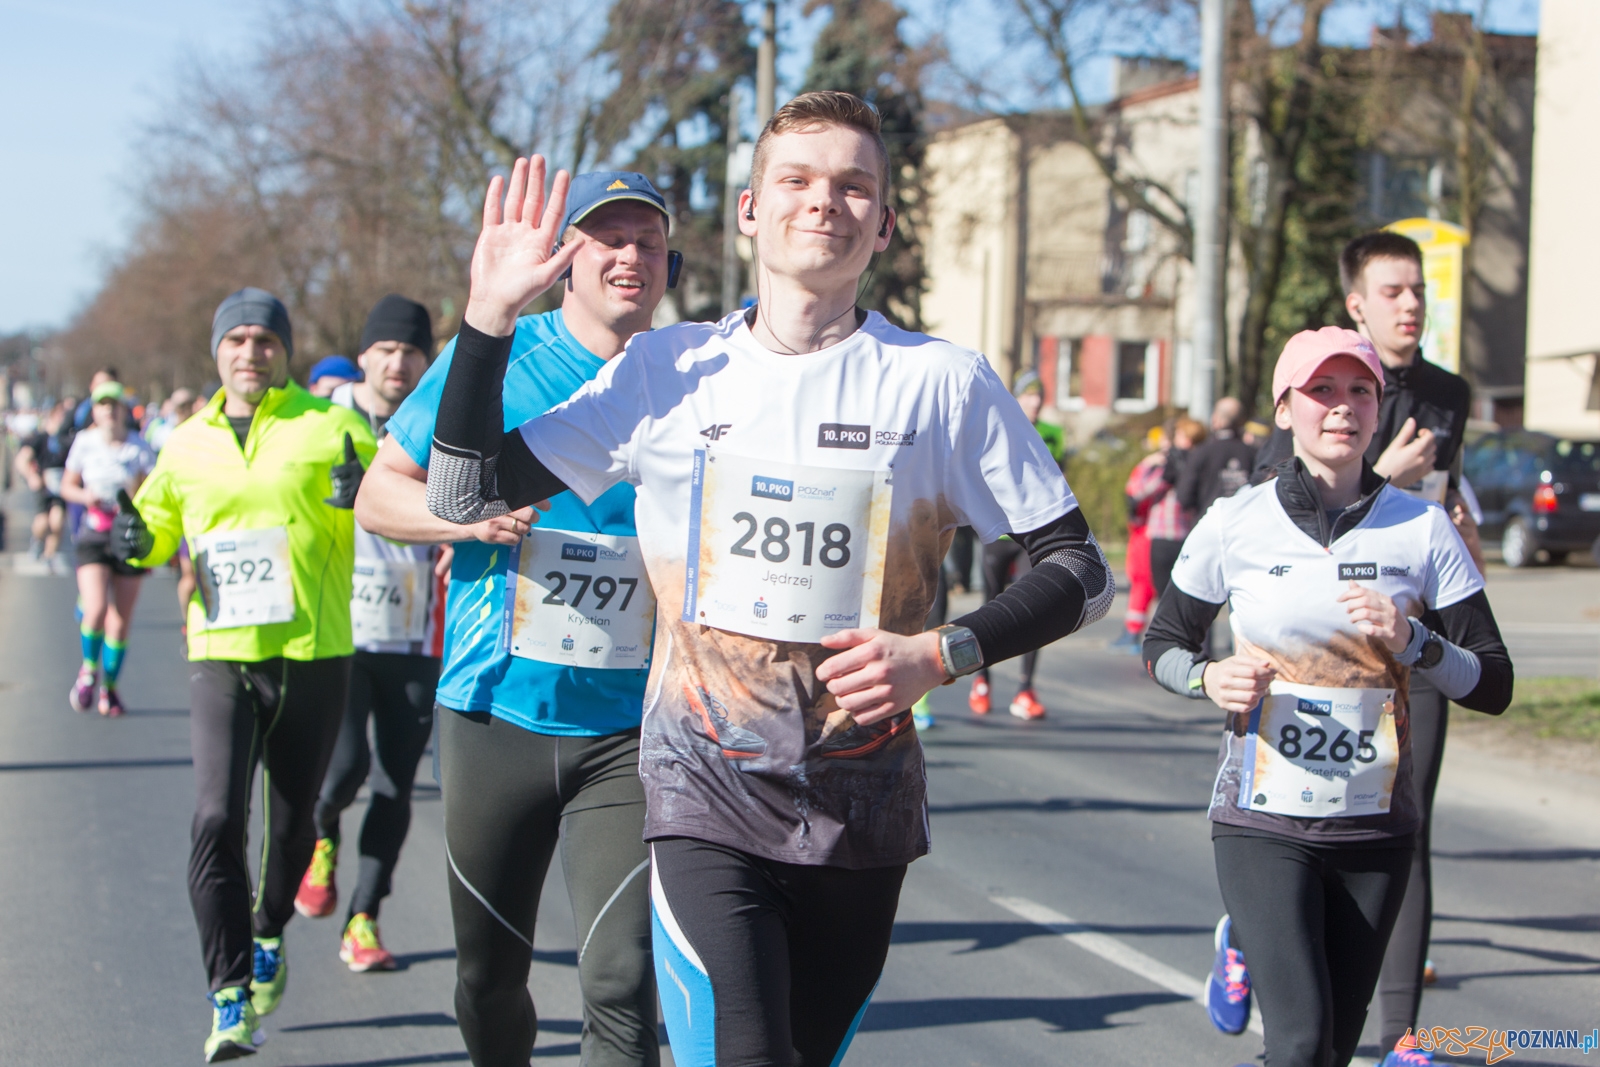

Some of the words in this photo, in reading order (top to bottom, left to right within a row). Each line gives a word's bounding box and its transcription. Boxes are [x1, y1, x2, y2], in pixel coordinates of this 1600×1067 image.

[699, 424, 733, 441] 4F
[730, 511, 851, 569] 2818
[210, 558, 274, 587] 5292
[762, 570, 813, 590] Jędrzej
[1268, 565, 1293, 577] 4F
[352, 585, 401, 605] 474
[542, 571, 638, 612] 2797
[568, 613, 610, 626] Krystian
[1278, 724, 1377, 763] 8265
